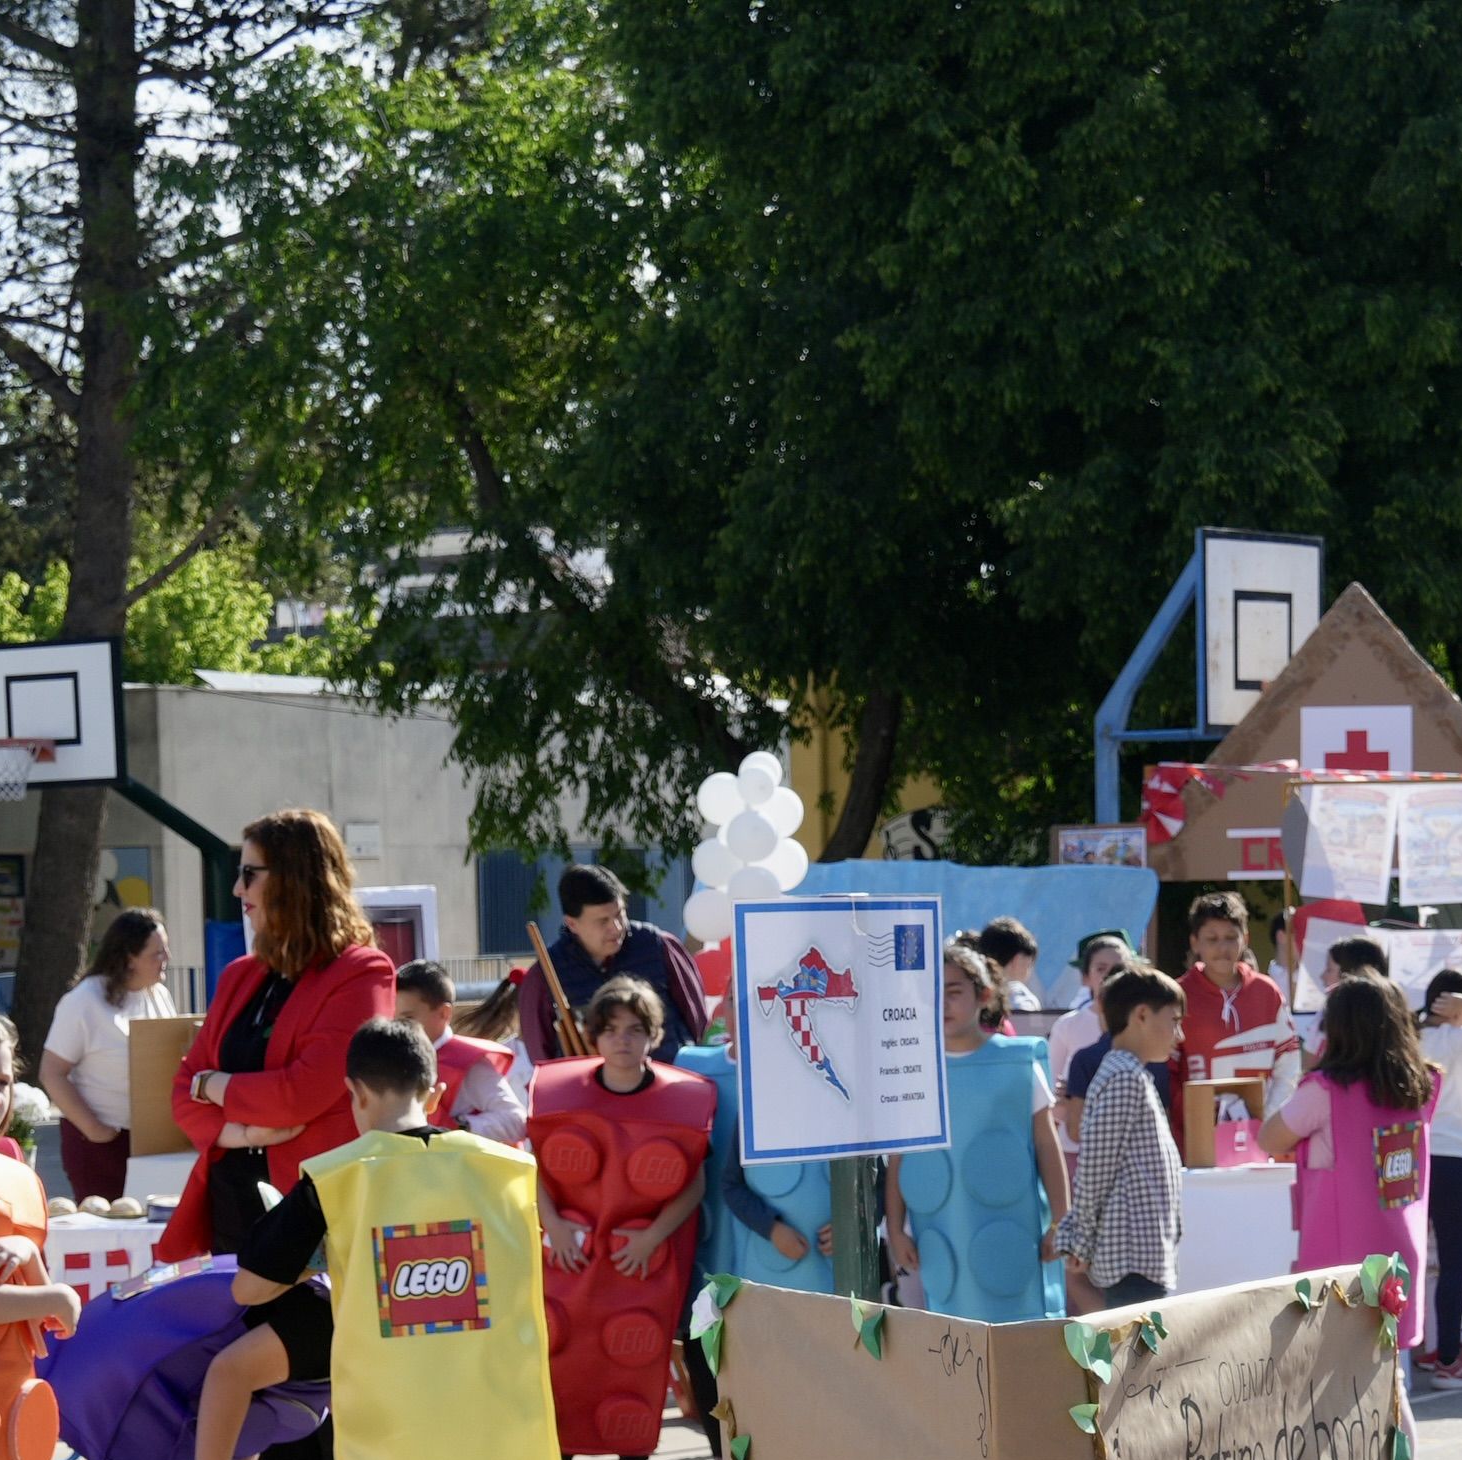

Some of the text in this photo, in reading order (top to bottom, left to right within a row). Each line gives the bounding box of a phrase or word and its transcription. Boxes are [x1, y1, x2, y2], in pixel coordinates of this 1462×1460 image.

[882, 1007, 918, 1022] CROACIA
[1384, 1149, 1413, 1180] LEGO
[393, 1258, 469, 1298] LEGO
[1217, 1356, 1276, 1408] CUENTO
